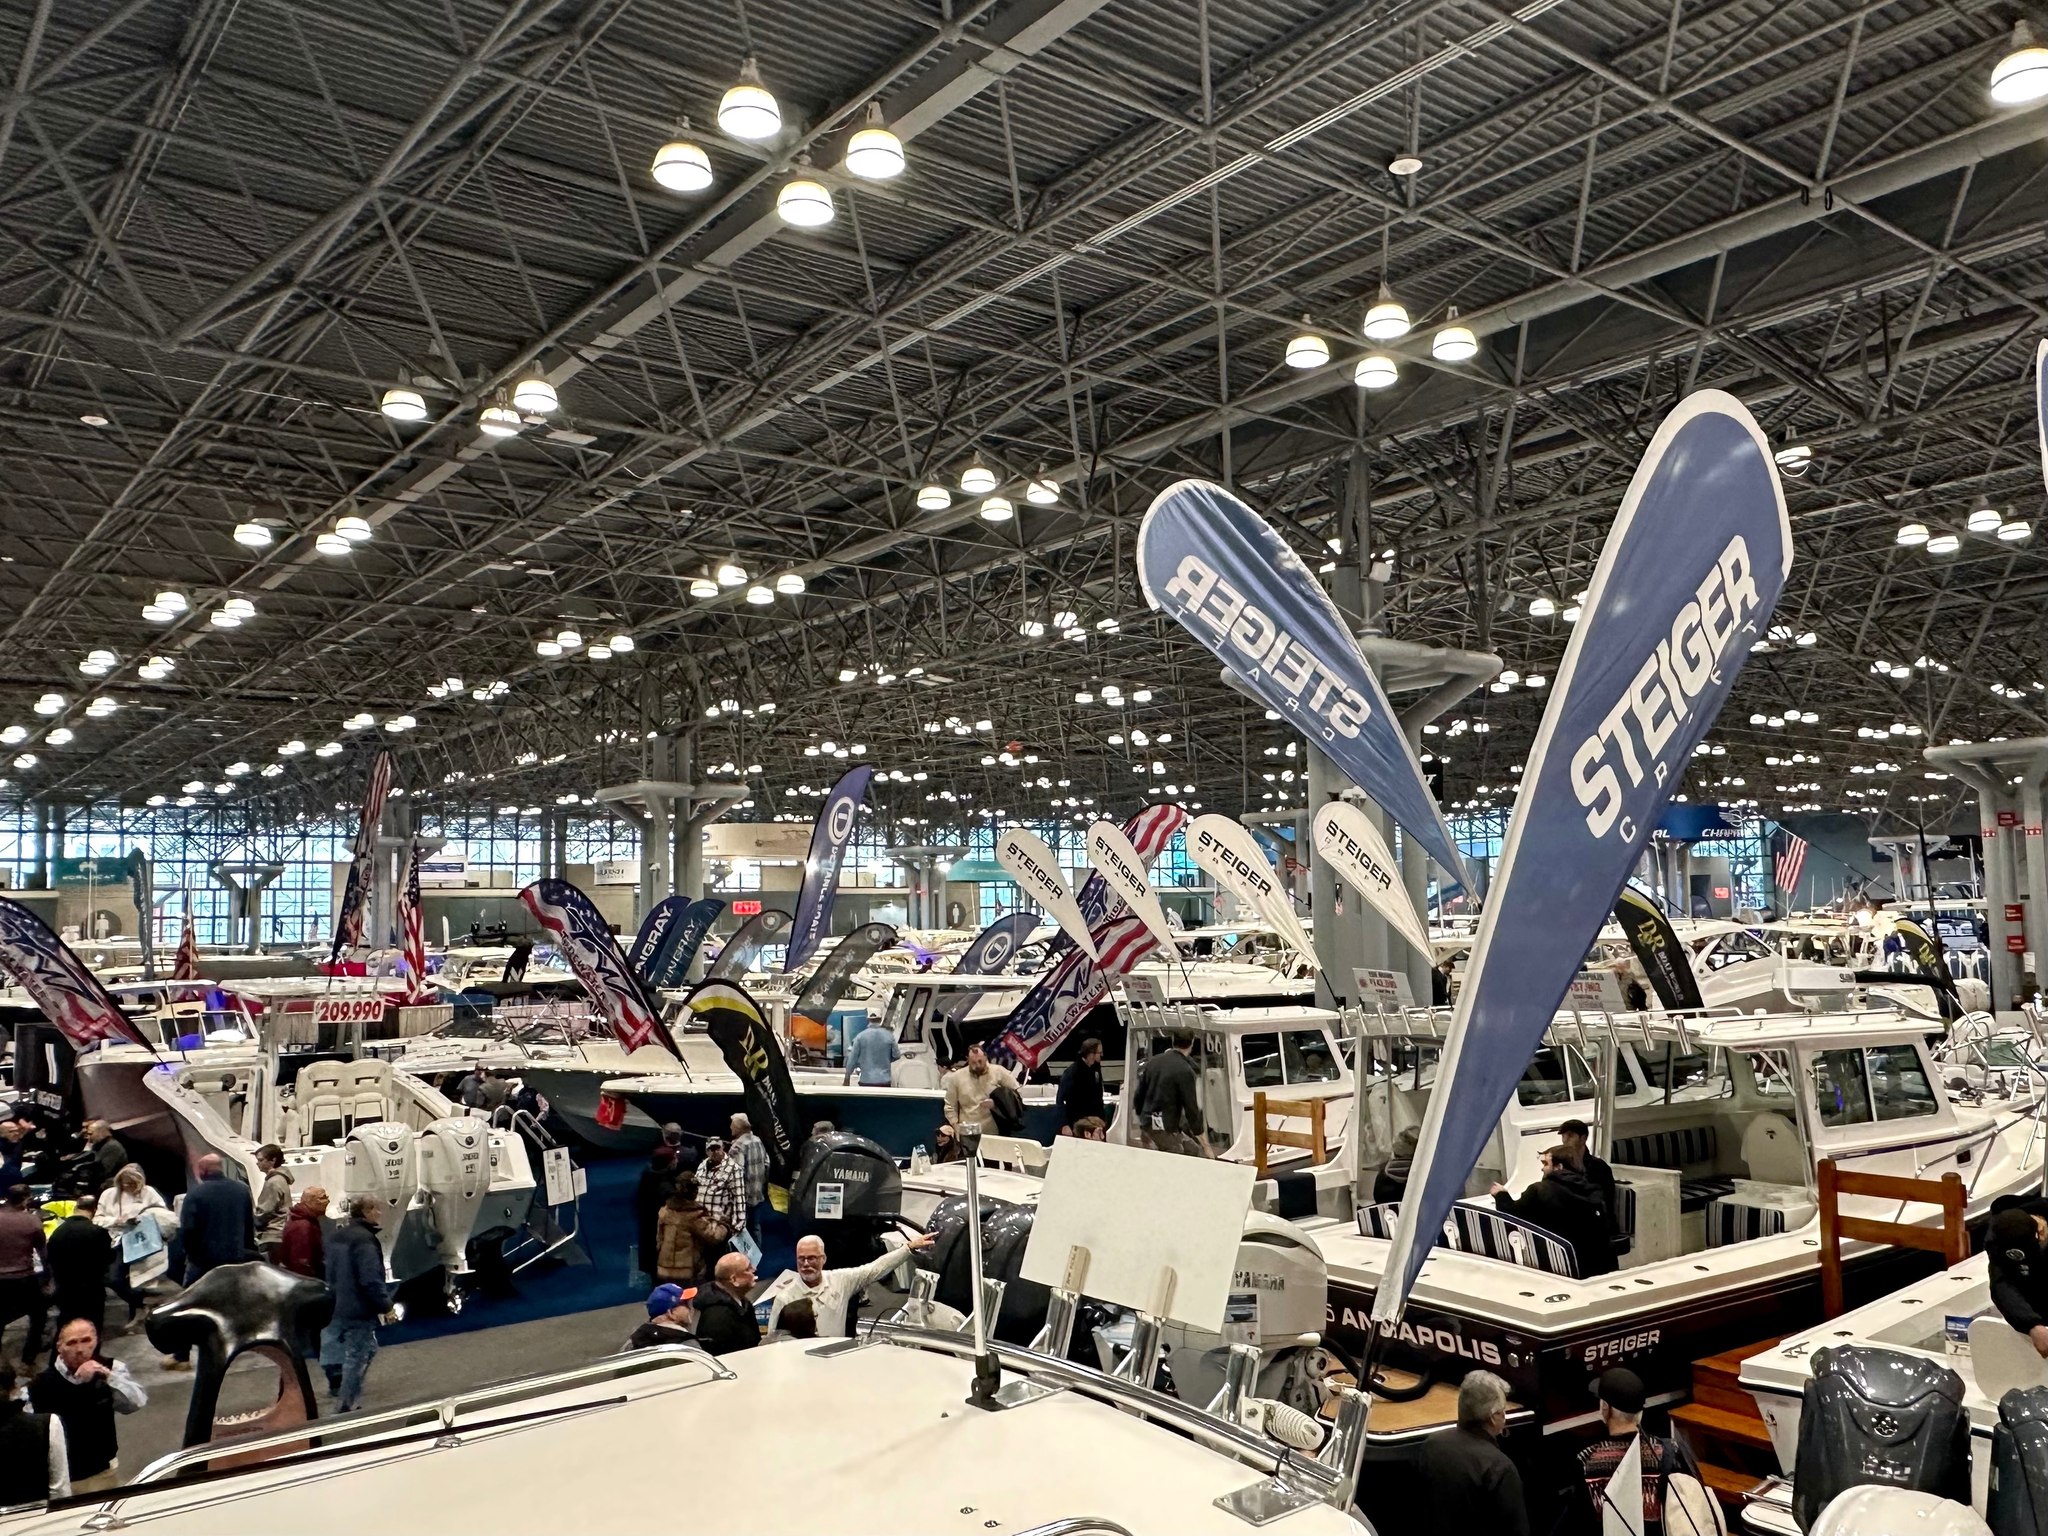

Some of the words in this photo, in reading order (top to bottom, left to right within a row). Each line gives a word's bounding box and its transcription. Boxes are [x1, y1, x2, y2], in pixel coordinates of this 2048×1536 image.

[1571, 535, 1760, 839] STEIGER
[1007, 842, 1063, 900] STEIGER
[1095, 836, 1146, 898] STEIGER
[1198, 830, 1272, 897] STEIGER
[1325, 819, 1391, 890] STEIGER
[833, 1167, 869, 1182] YAMAHA
[1584, 1329, 1660, 1362] STEIGER
